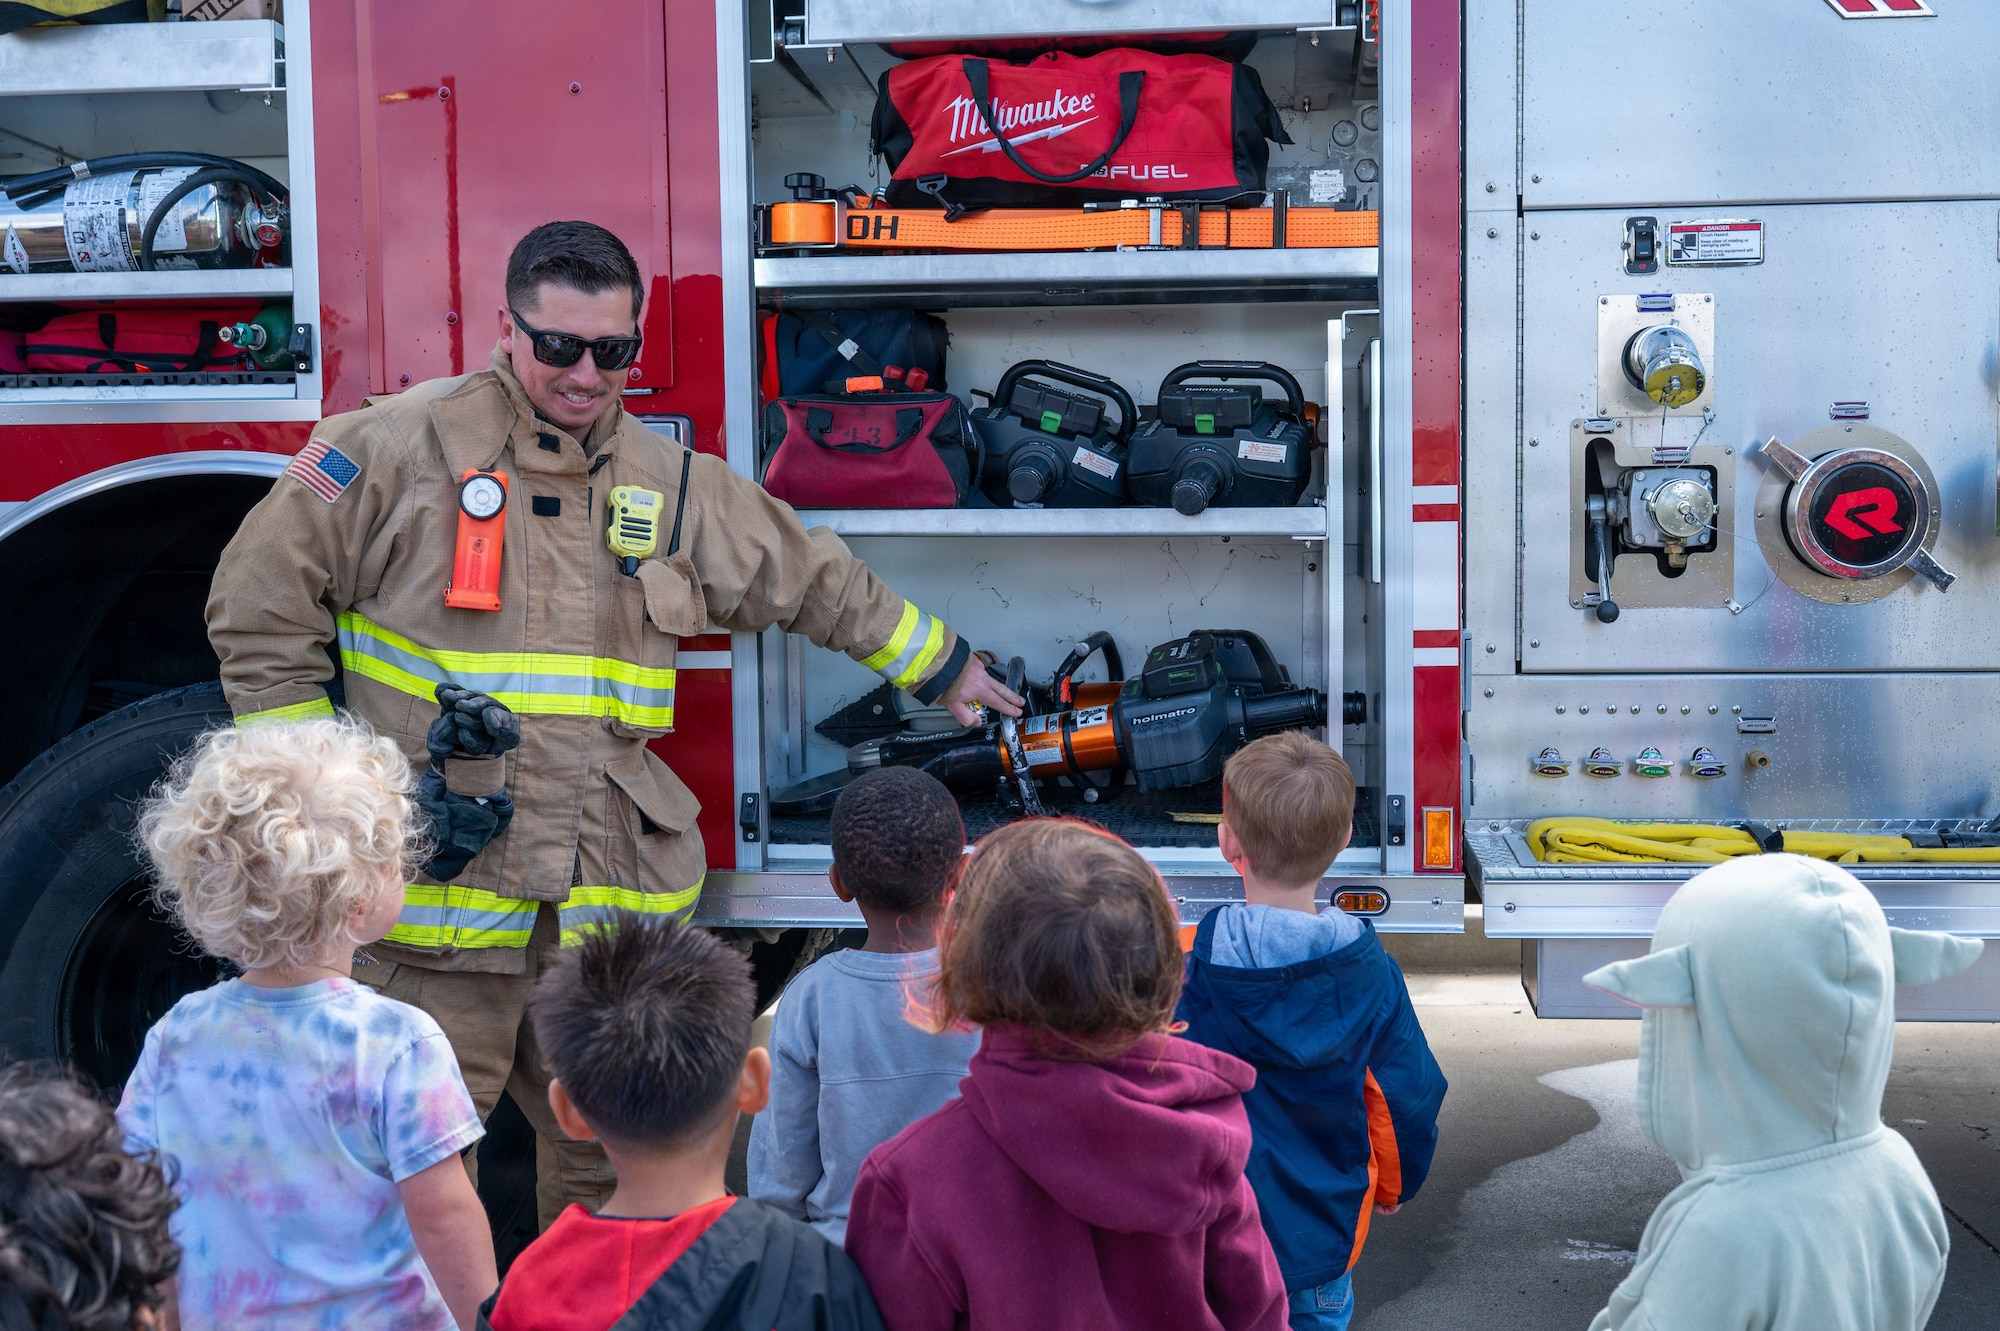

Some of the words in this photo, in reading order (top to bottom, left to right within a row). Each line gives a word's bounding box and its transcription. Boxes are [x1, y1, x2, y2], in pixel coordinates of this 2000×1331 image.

[1110, 164, 1188, 180] FUEL
[1132, 706, 1196, 726] holmatro
[895, 731, 953, 742] holmatro
